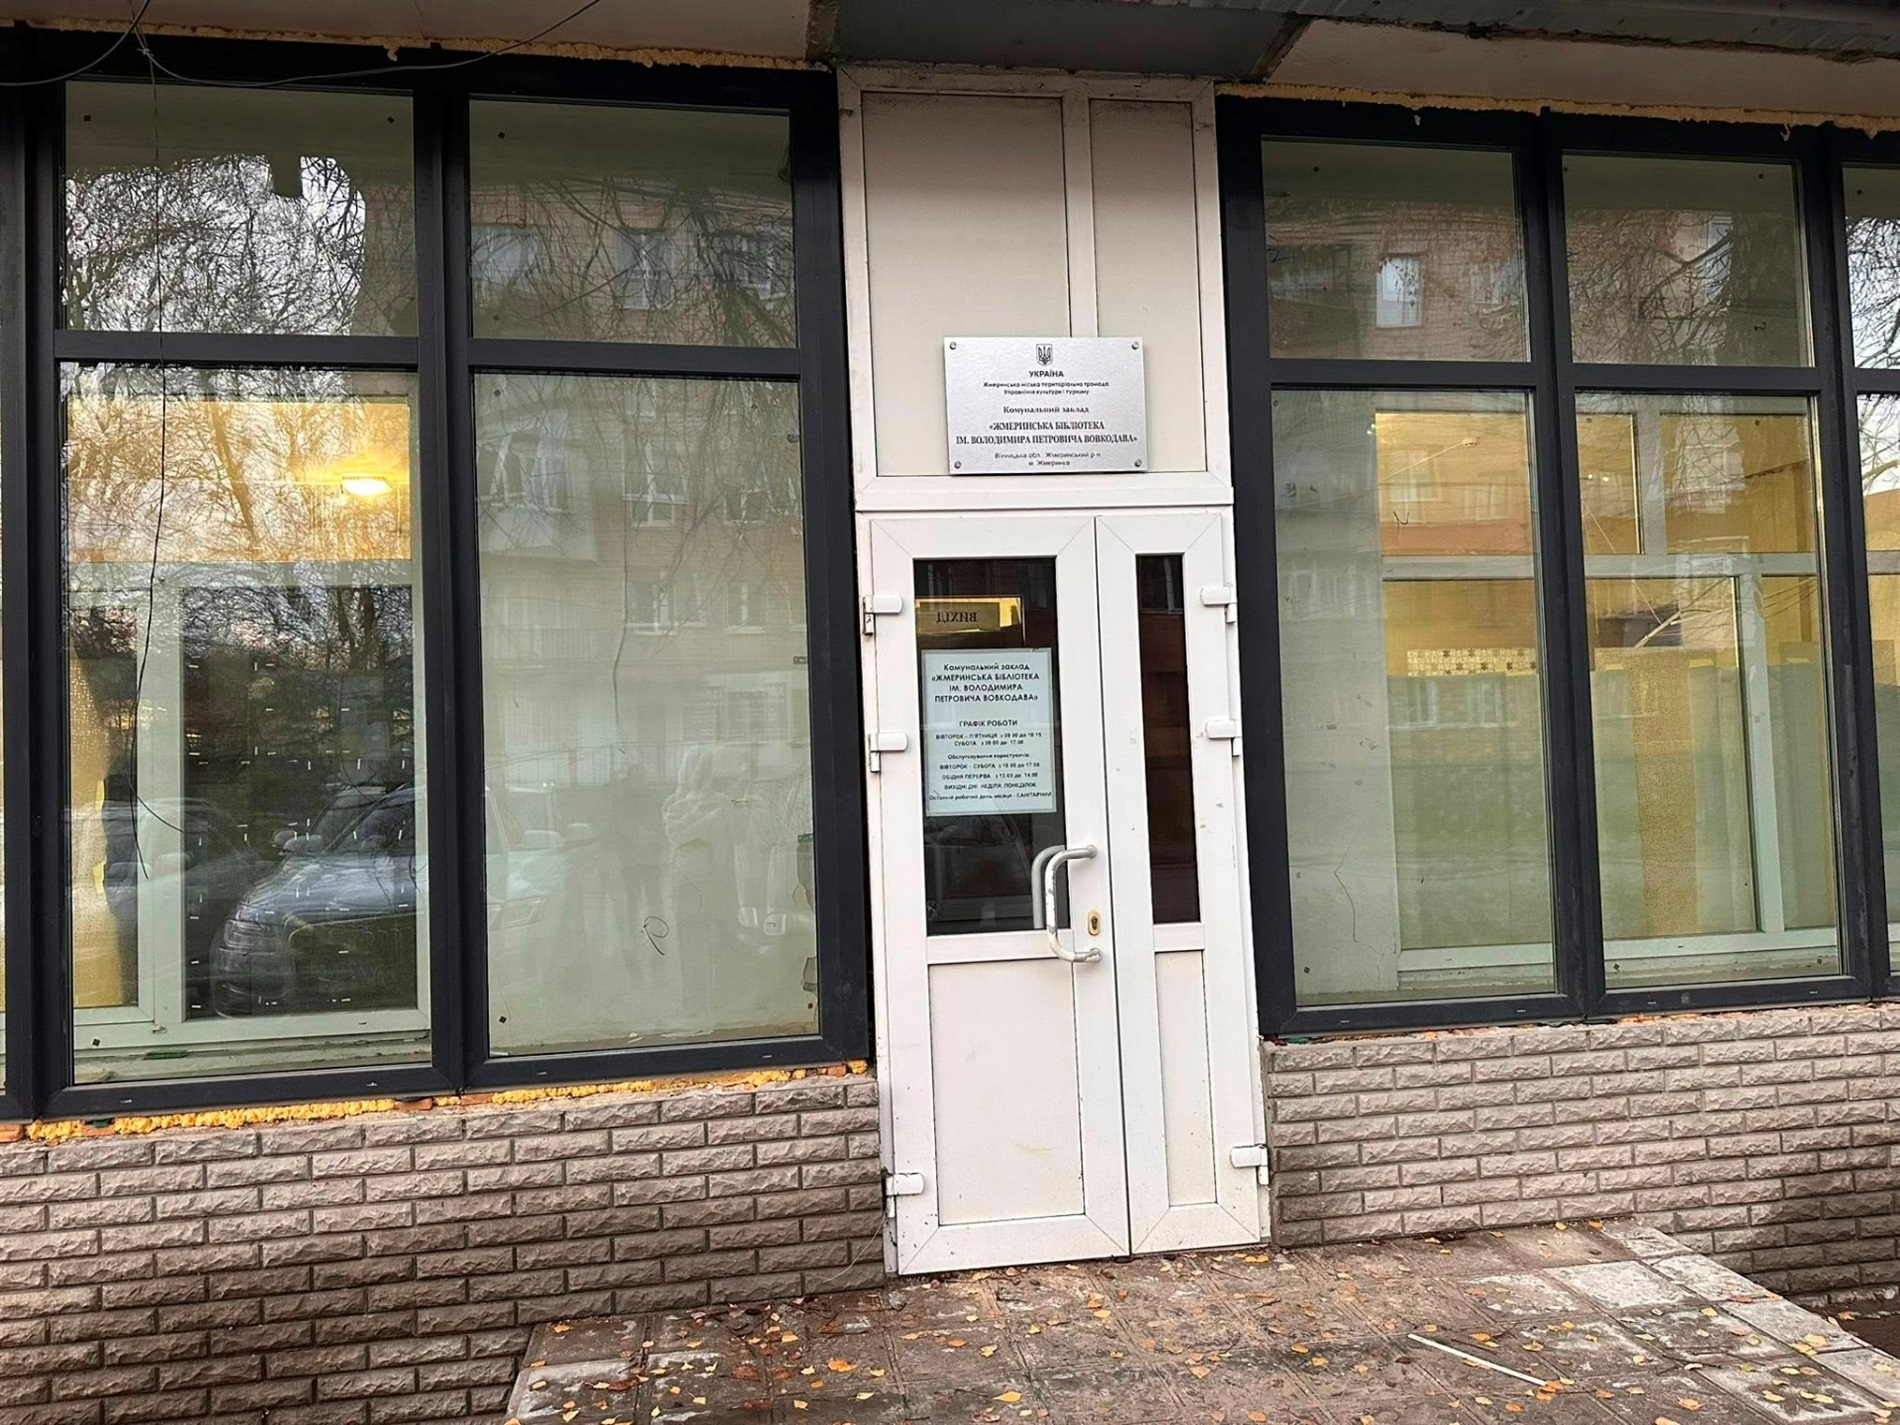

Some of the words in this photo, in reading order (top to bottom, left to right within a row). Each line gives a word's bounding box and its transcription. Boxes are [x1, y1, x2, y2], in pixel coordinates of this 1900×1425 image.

[1028, 369, 1064, 378] УКРАЇНА
[1003, 406, 1060, 414] Комунальний
[989, 421, 1054, 431] «ЖМЕРИНСЬКА
[1055, 420, 1105, 430] БІБЛІОТЕКА
[956, 436, 970, 445] ІМ.
[971, 435, 1032, 445] ВОЛОДИМИРА
[1032, 434, 1083, 444] ПЕТРОВИЧА
[1084, 433, 1137, 443] ВОВКОДАВА»
[943, 663, 999, 673] Комунальний
[931, 674, 992, 682] «ЖМЕРИНСЬКА
[994, 673, 1040, 681] БІБЛІОТЕКА
[949, 684, 961, 692] ІМ.
[963, 683, 1023, 692] ВОЛОДИМИРА
[934, 694, 981, 703] ПЕТРОВИЧА
[983, 693, 1039, 702] ВОВКОДАВА»
[987, 719, 1018, 727] РОБОТИ
